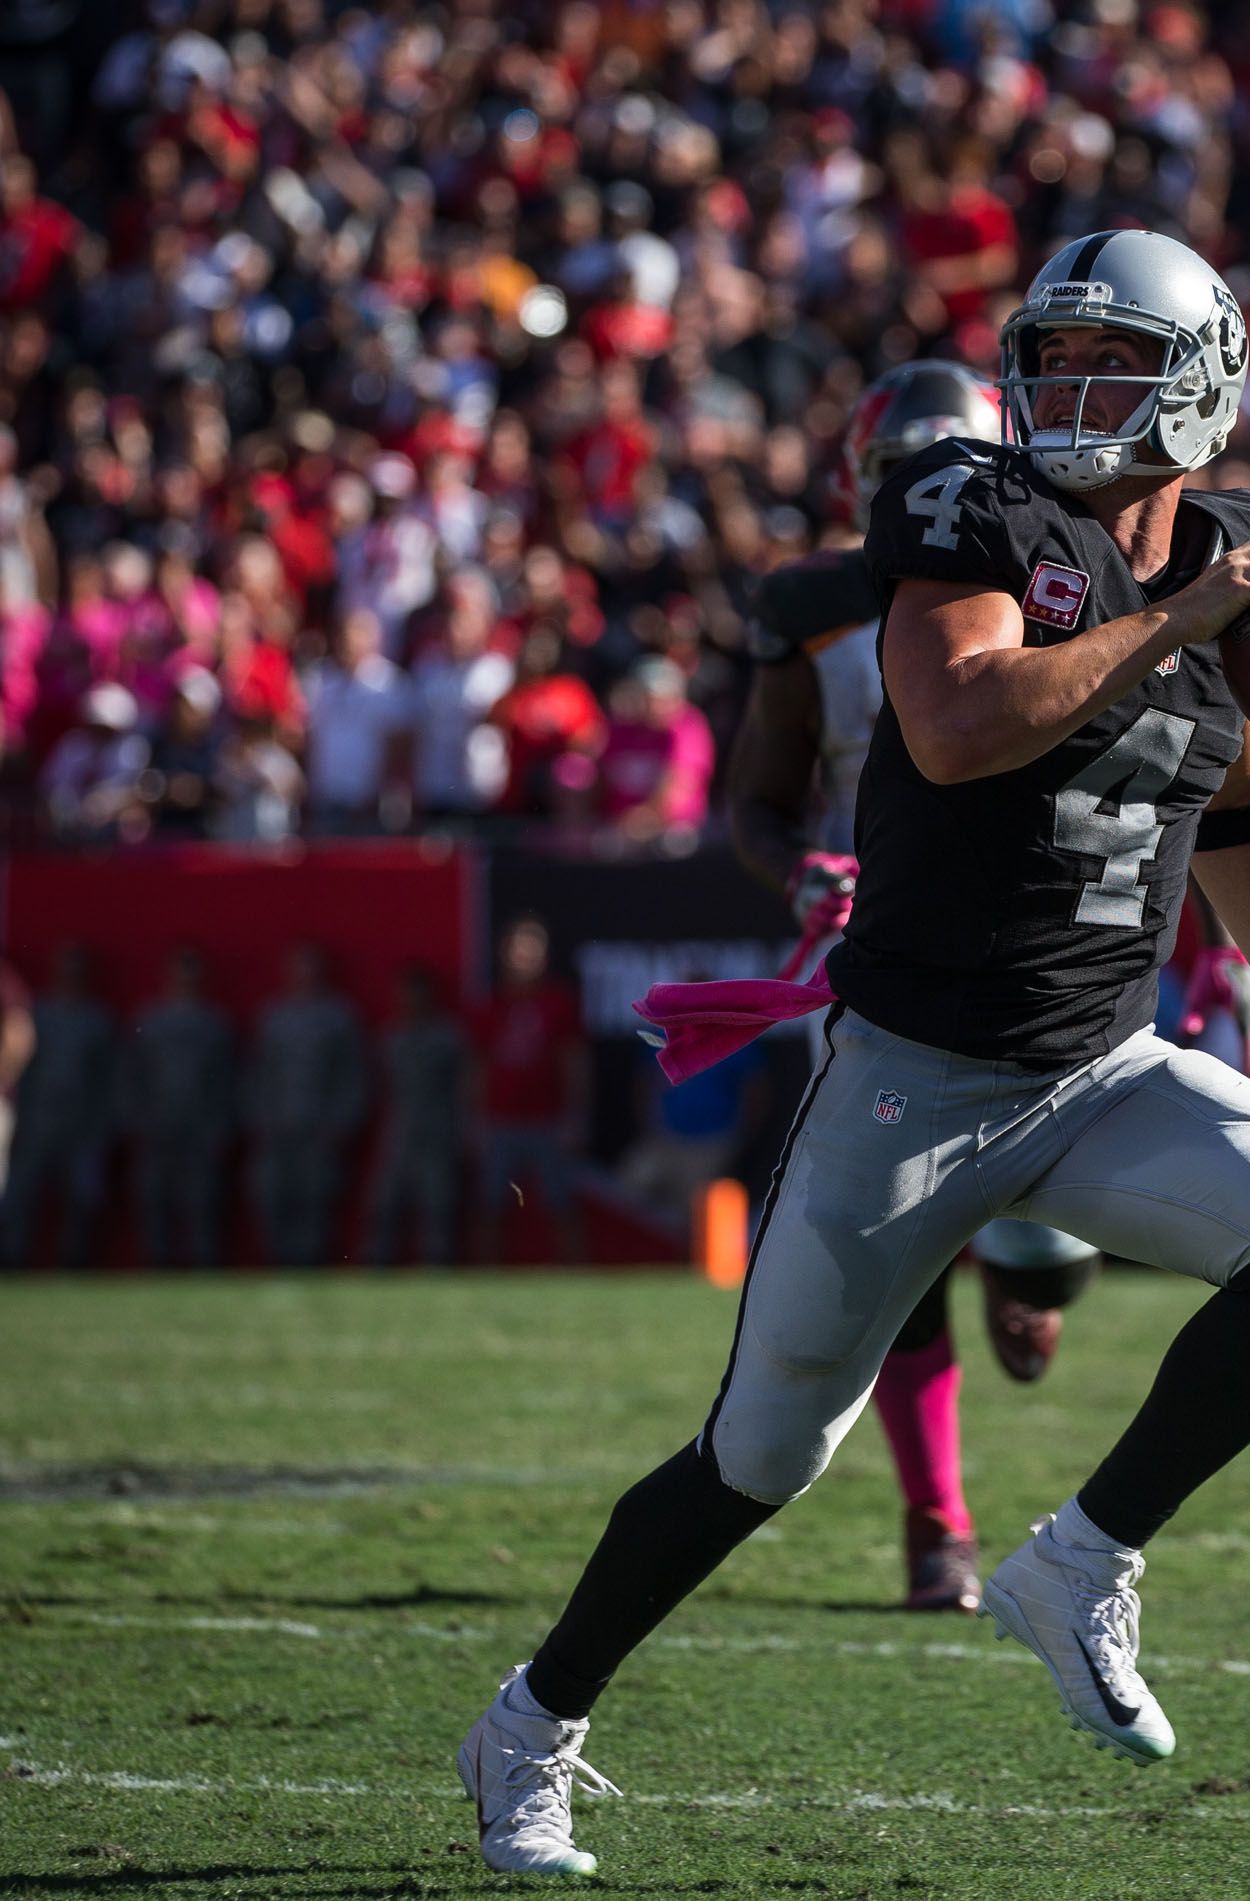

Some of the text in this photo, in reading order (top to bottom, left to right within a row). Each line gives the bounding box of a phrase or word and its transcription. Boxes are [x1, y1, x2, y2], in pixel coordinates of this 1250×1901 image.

[1051, 286, 1090, 297] RAIDERS
[904, 464, 975, 551] 4
[1032, 567, 1083, 612] C
[1053, 707, 1197, 928] 4
[877, 1102, 899, 1120] NFL
